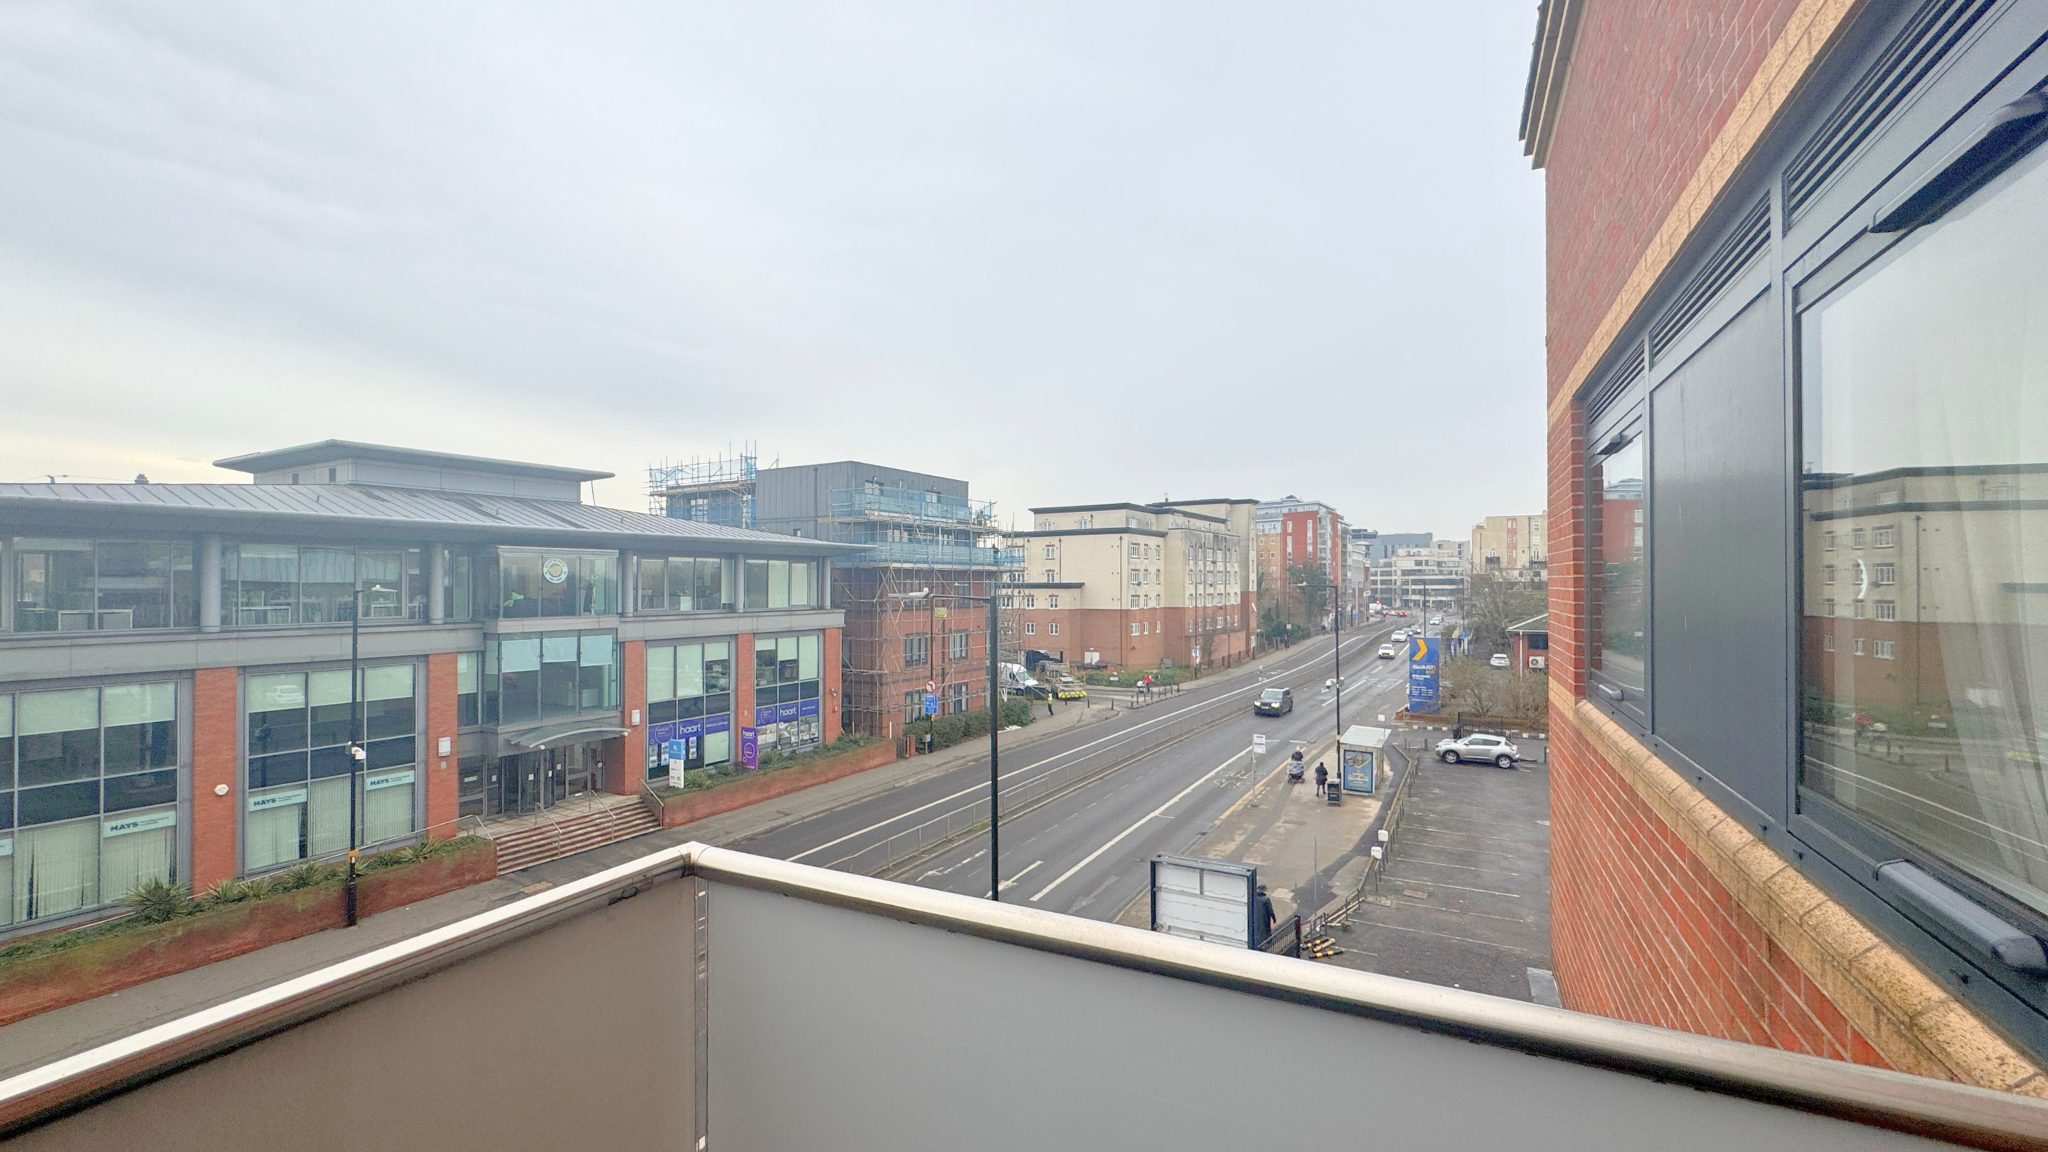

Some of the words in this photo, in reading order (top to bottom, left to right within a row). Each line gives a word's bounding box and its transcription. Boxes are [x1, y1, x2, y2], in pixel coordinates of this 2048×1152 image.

[780, 706, 797, 716] haart
[680, 723, 702, 735] haart
[370, 778, 389, 786] HAYS
[253, 797, 277, 806] HAYS
[110, 821, 139, 832] HAYS
